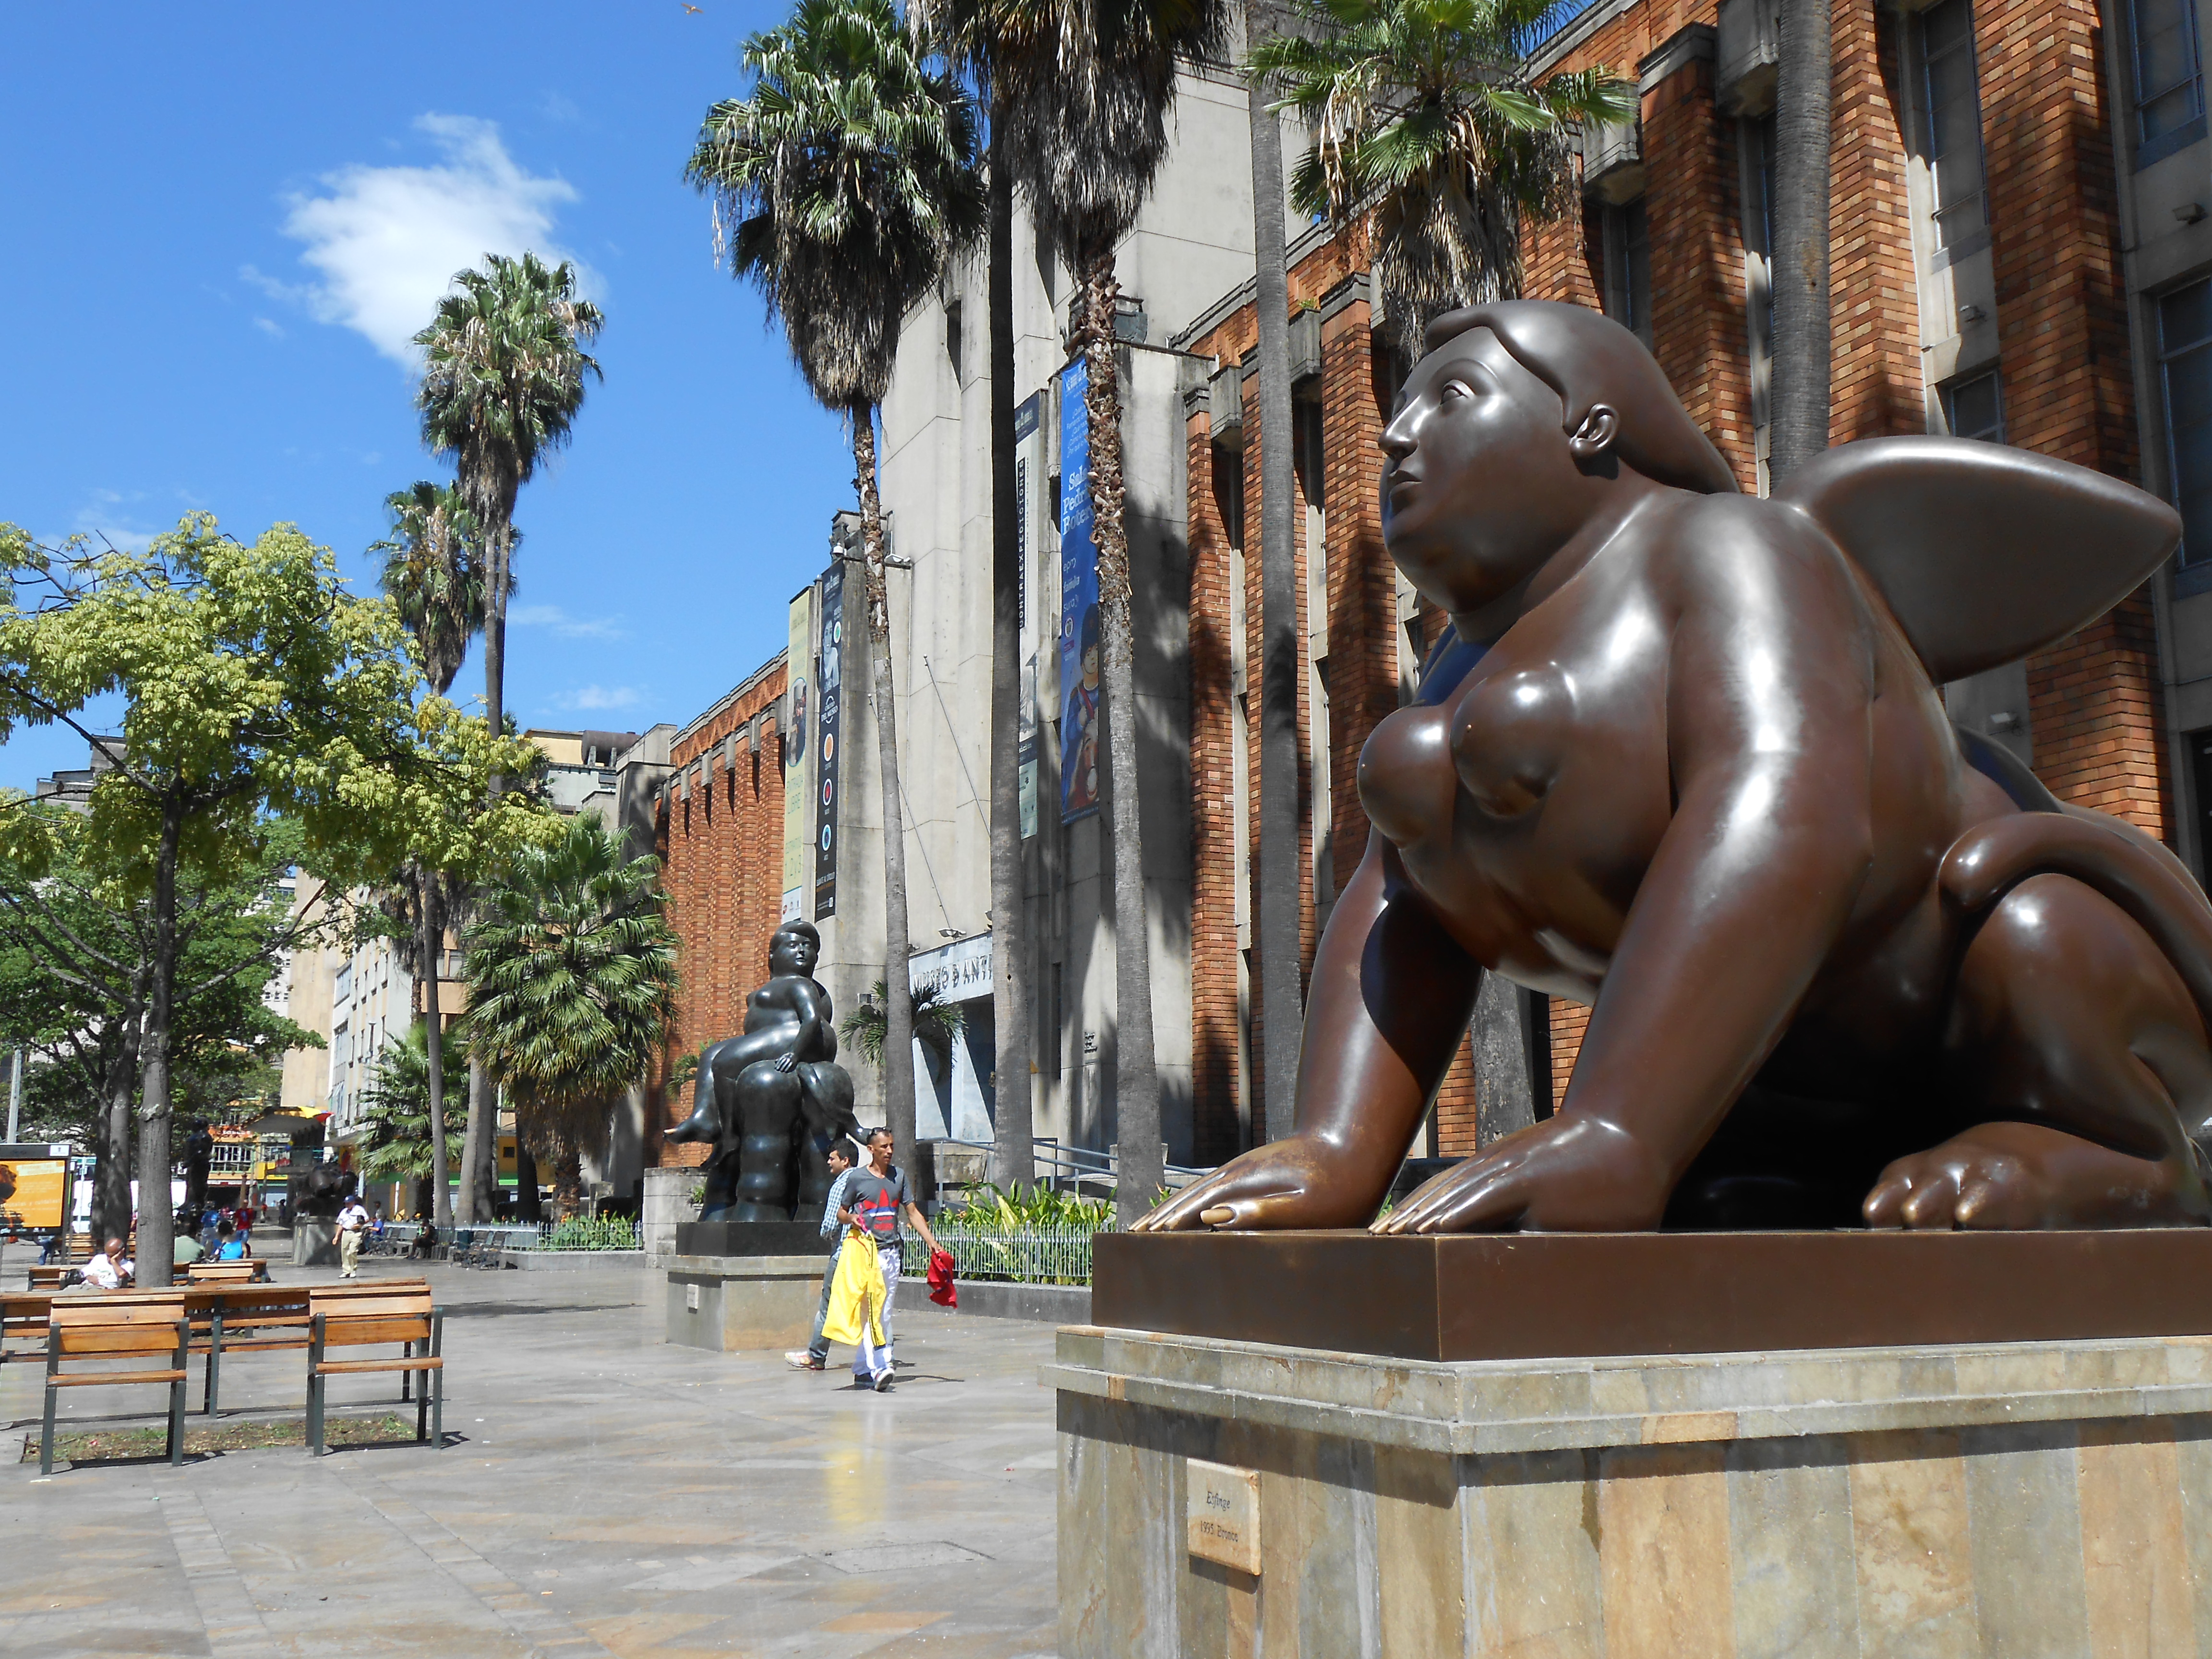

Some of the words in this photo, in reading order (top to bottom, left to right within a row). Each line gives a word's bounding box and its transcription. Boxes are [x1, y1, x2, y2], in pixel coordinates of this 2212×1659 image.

[1063, 487, 1091, 515] Pedri
[1063, 505, 1094, 535] Boter
[1063, 557, 1076, 573] epm
[963, 954, 992, 981] ANTI
[1206, 1491, 1230, 1511] Esfinge
[1217, 1525, 1238, 1542] Bronce
